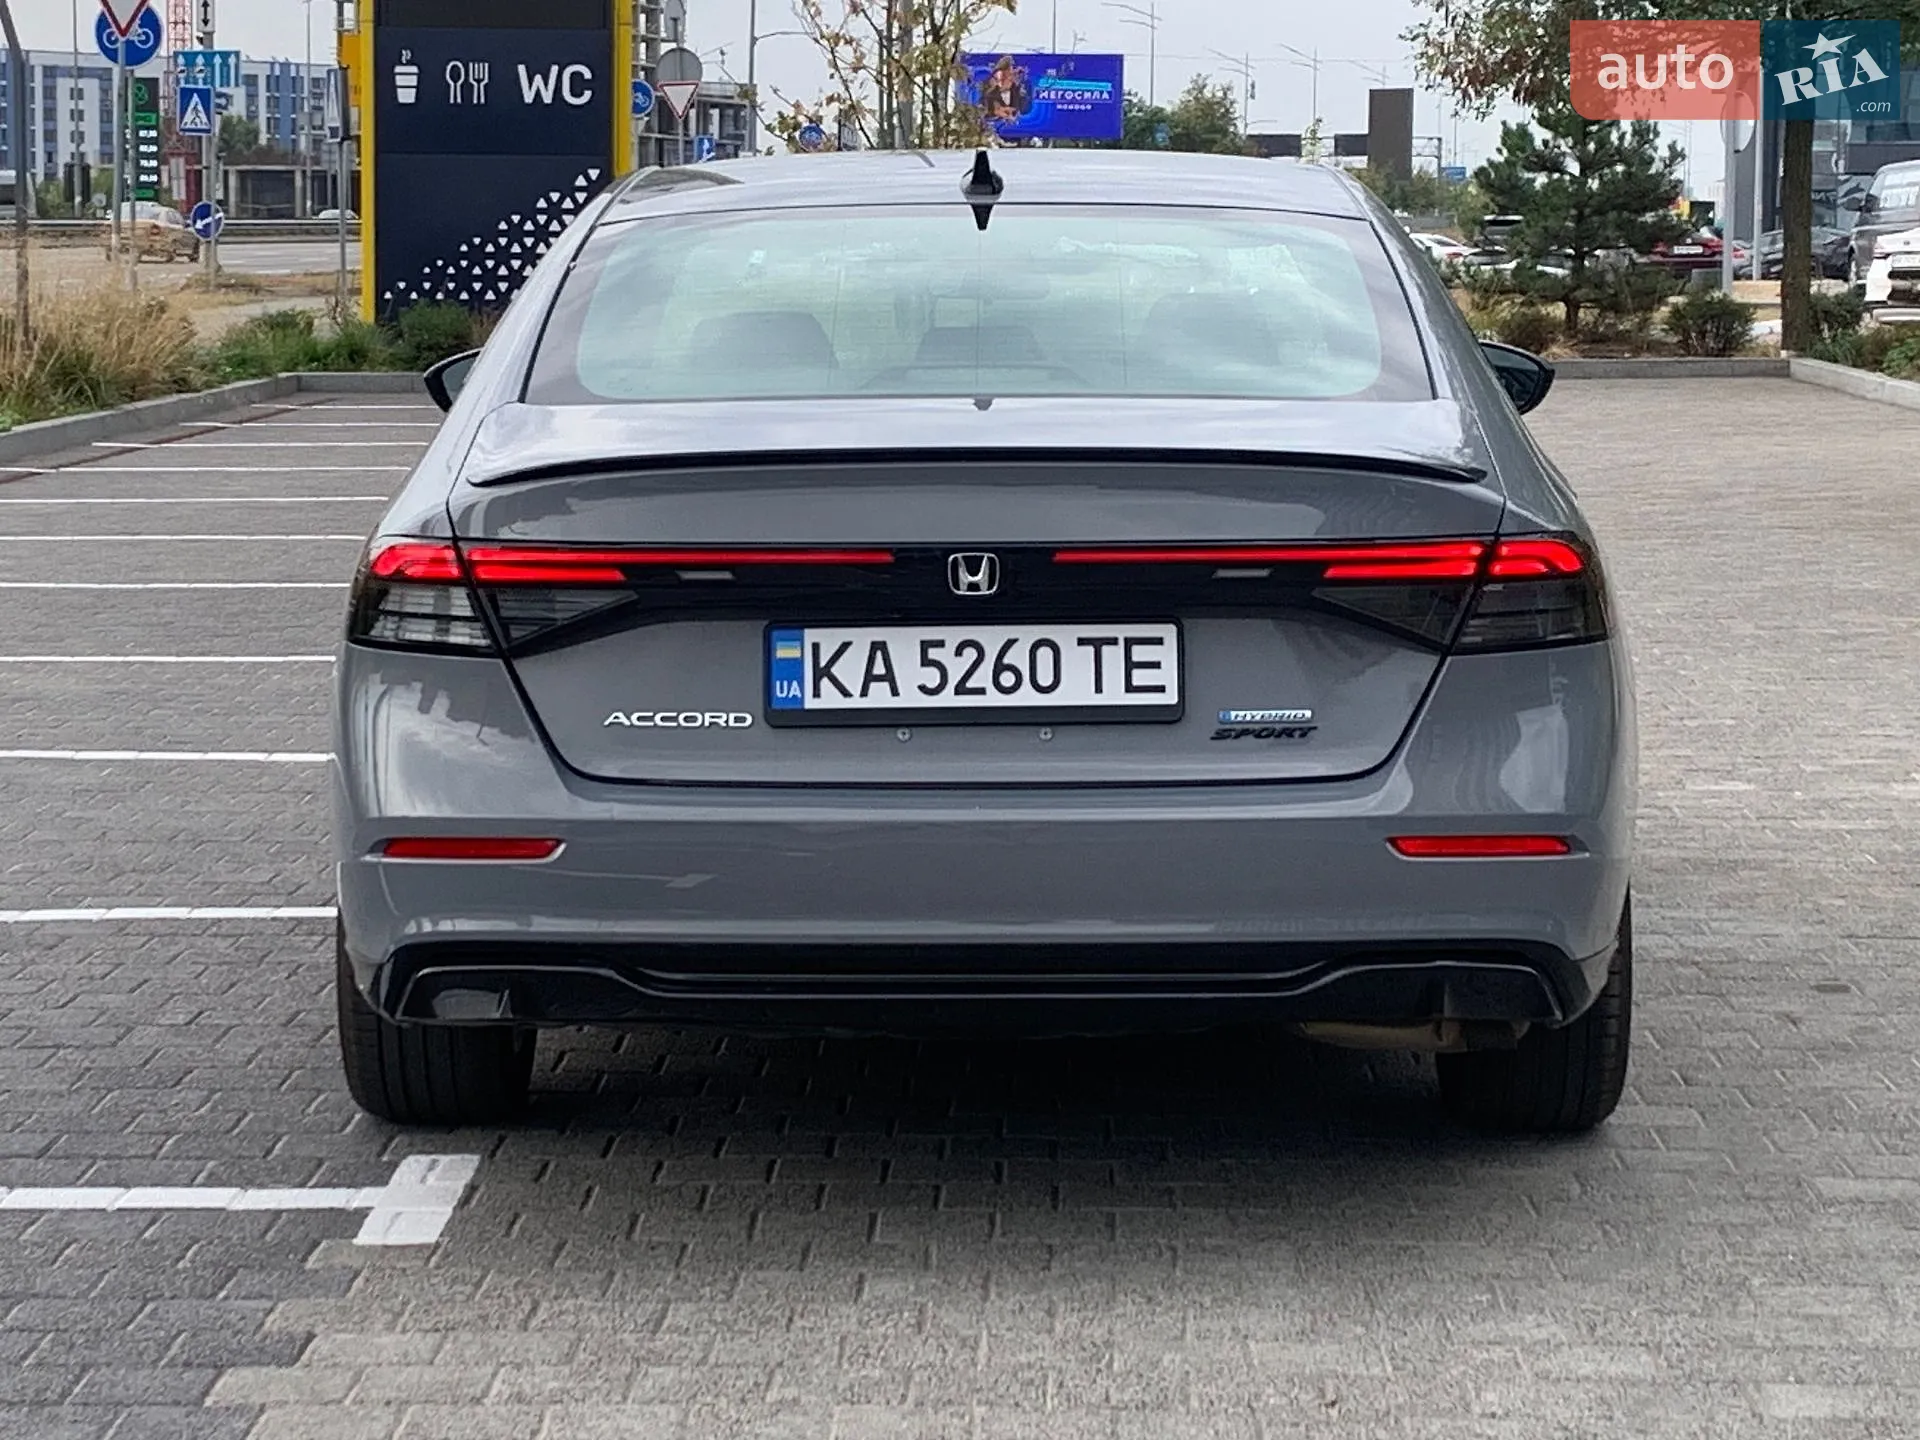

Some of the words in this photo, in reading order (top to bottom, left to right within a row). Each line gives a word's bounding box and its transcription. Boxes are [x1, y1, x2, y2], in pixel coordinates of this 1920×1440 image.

[517, 64, 592, 105] WC
[811, 640, 900, 698] KA
[917, 637, 1062, 696] 5260
[1076, 636, 1166, 694] TE
[775, 680, 802, 699] UA
[603, 711, 753, 727] ACCORD
[1210, 726, 1318, 740] SPORT
